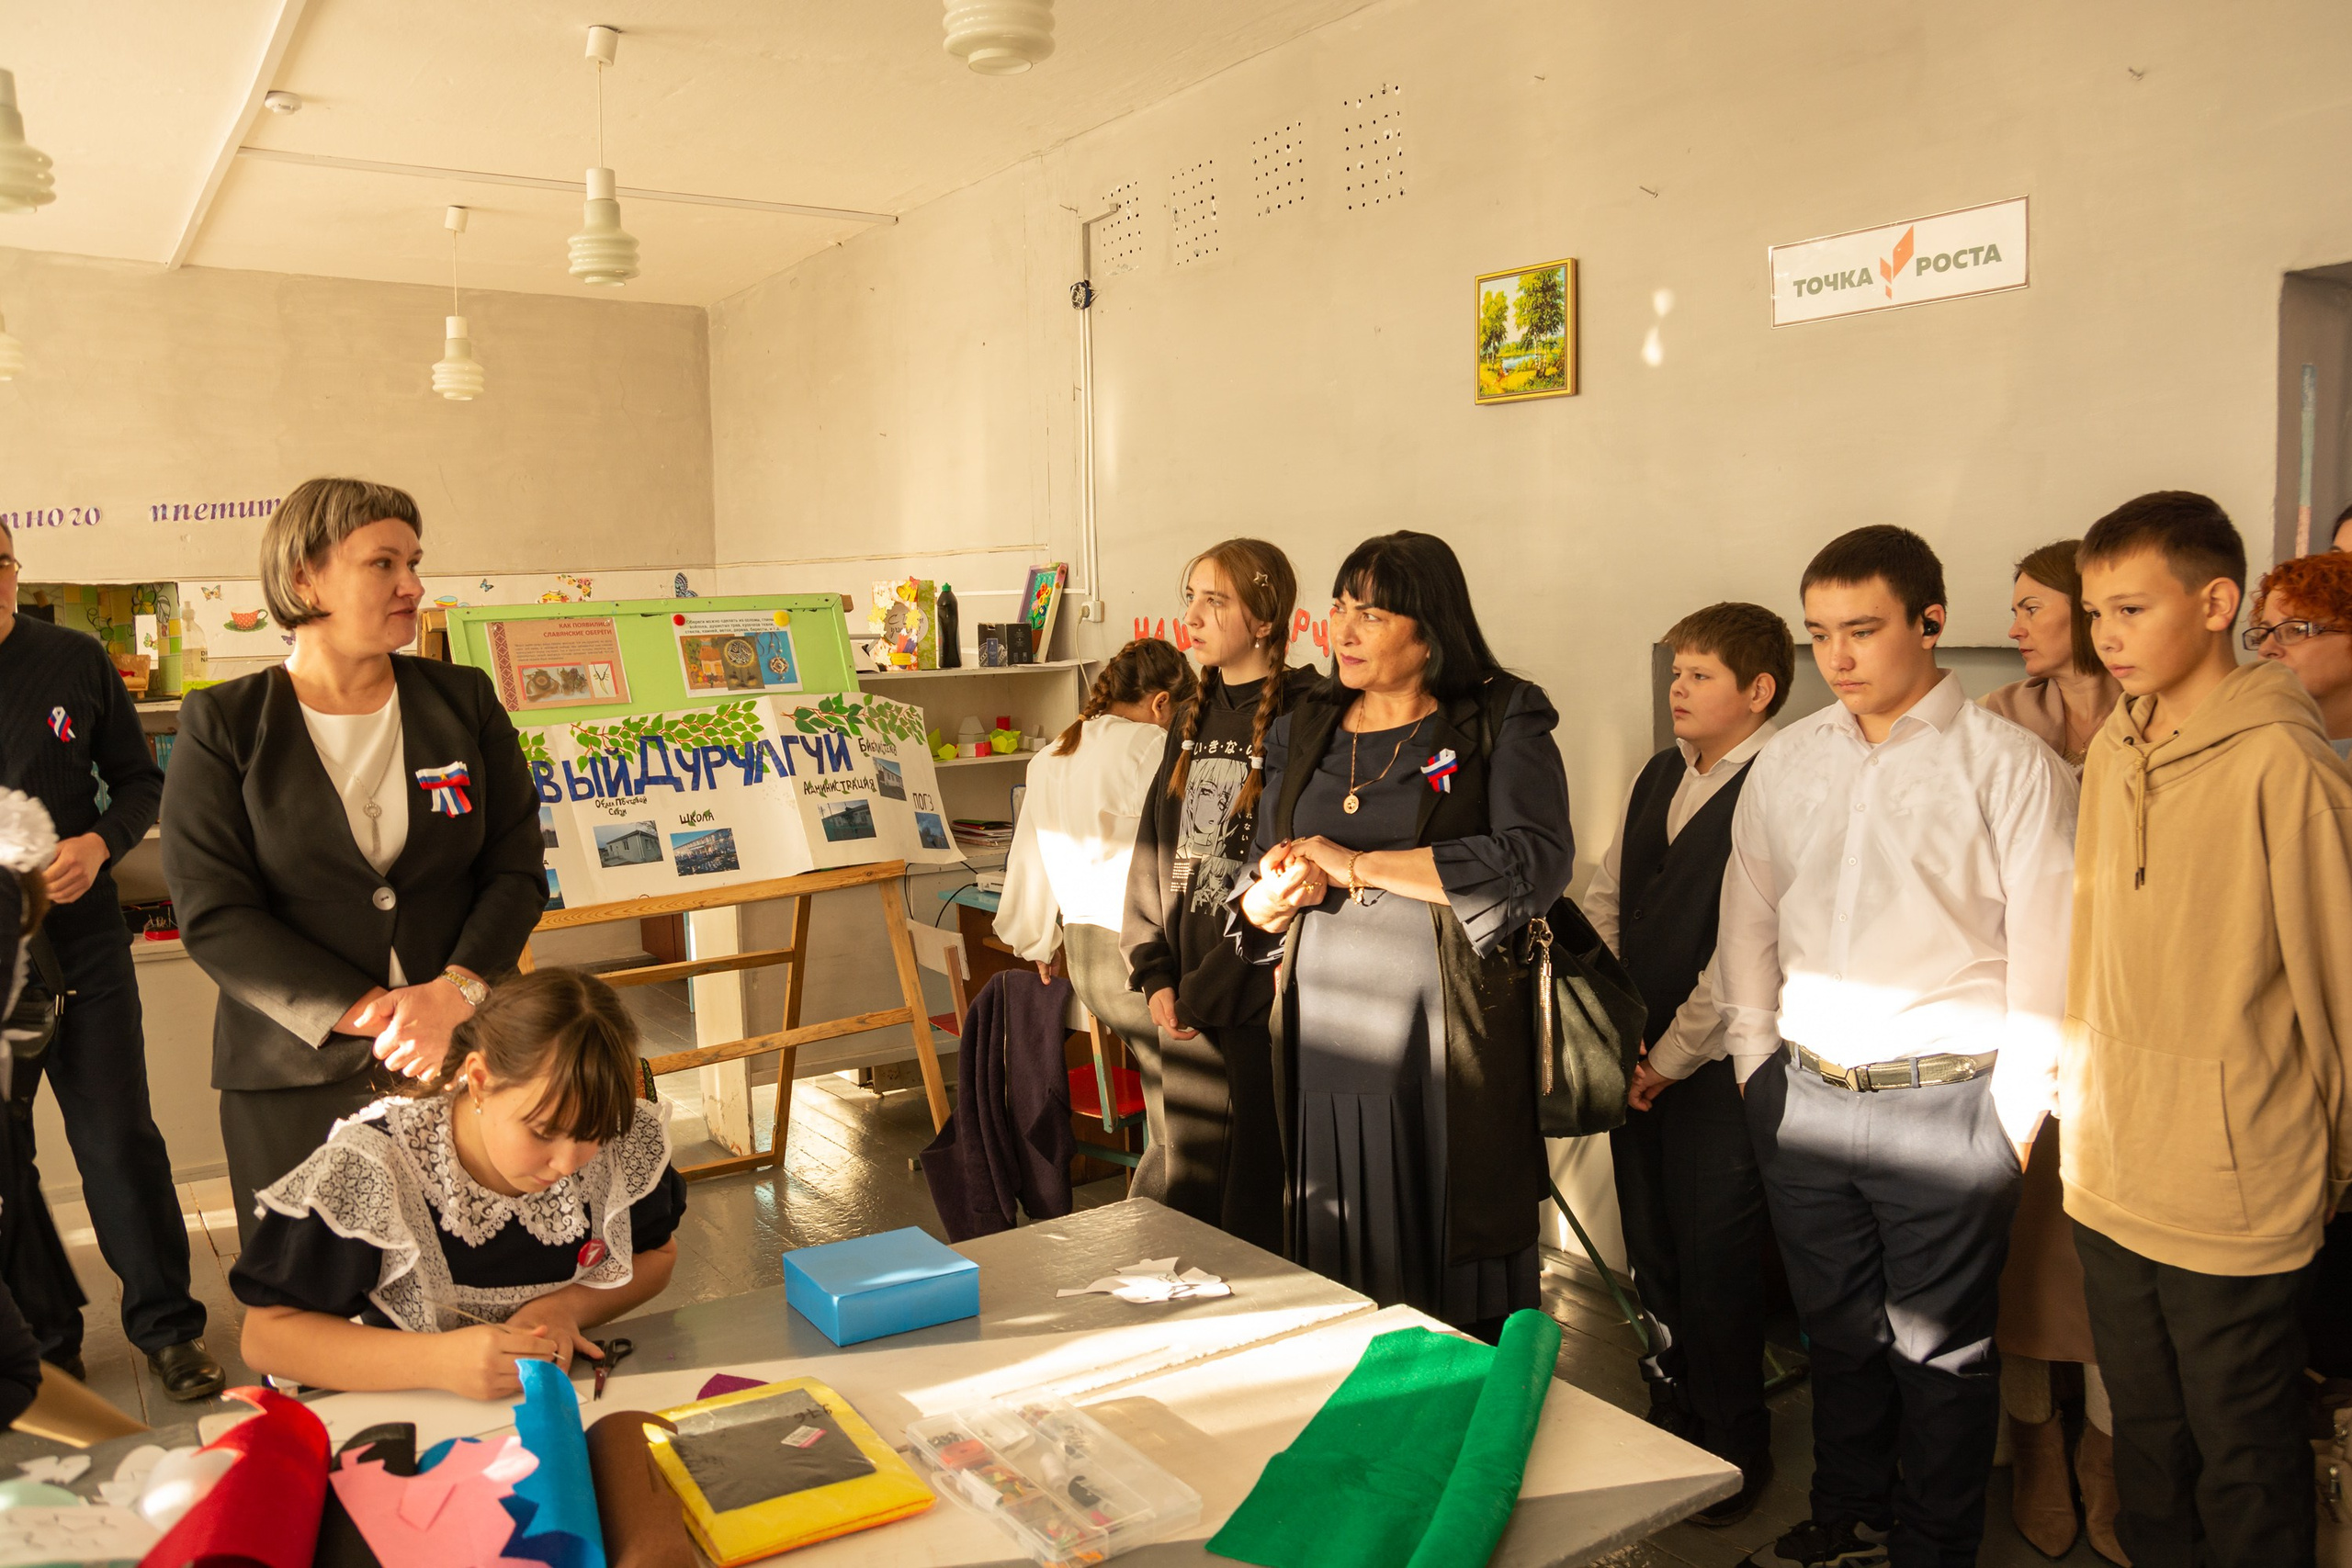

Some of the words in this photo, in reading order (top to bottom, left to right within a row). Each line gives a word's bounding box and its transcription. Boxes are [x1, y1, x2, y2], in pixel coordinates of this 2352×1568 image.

[1792, 267, 1873, 298] ТОЧКА
[1916, 243, 2002, 276] РОСТА
[543, 630, 583, 638] СЛАВЯНСКИЕ
[679, 812, 715, 824] ШКОЛА
